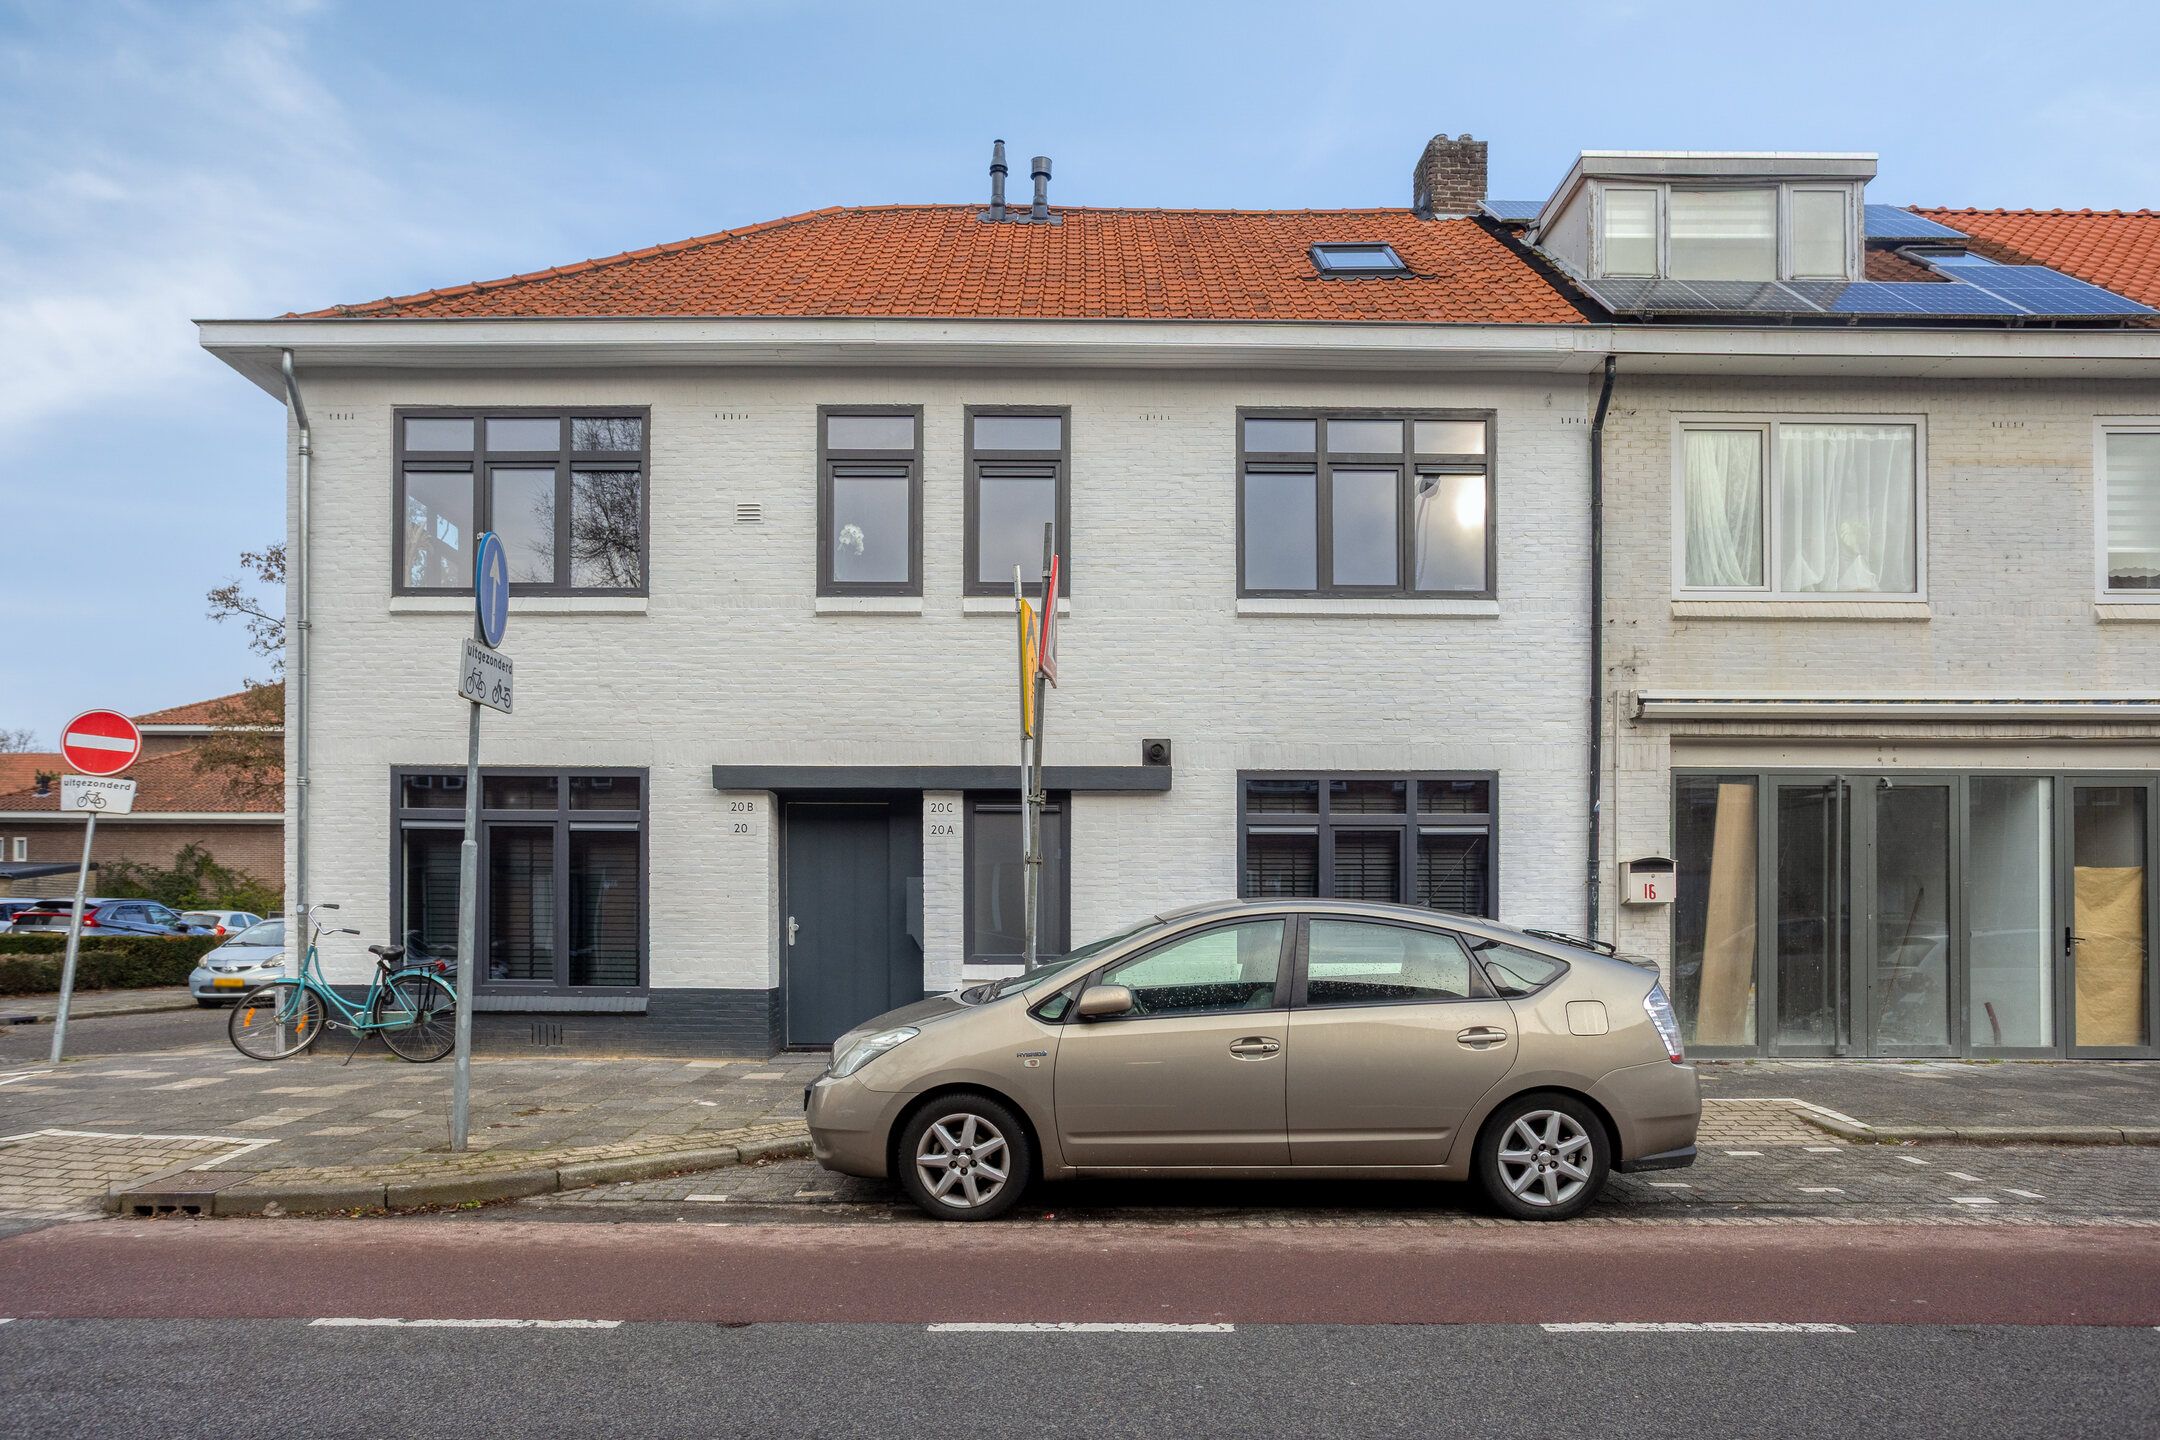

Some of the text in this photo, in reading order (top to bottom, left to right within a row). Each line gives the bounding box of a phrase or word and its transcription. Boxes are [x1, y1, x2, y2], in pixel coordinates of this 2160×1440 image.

[467, 645, 513, 675] uitgezonderd
[63, 779, 131, 791] uitgezonderd
[734, 823, 748, 833] 20
[1644, 883, 1656, 900] 16
